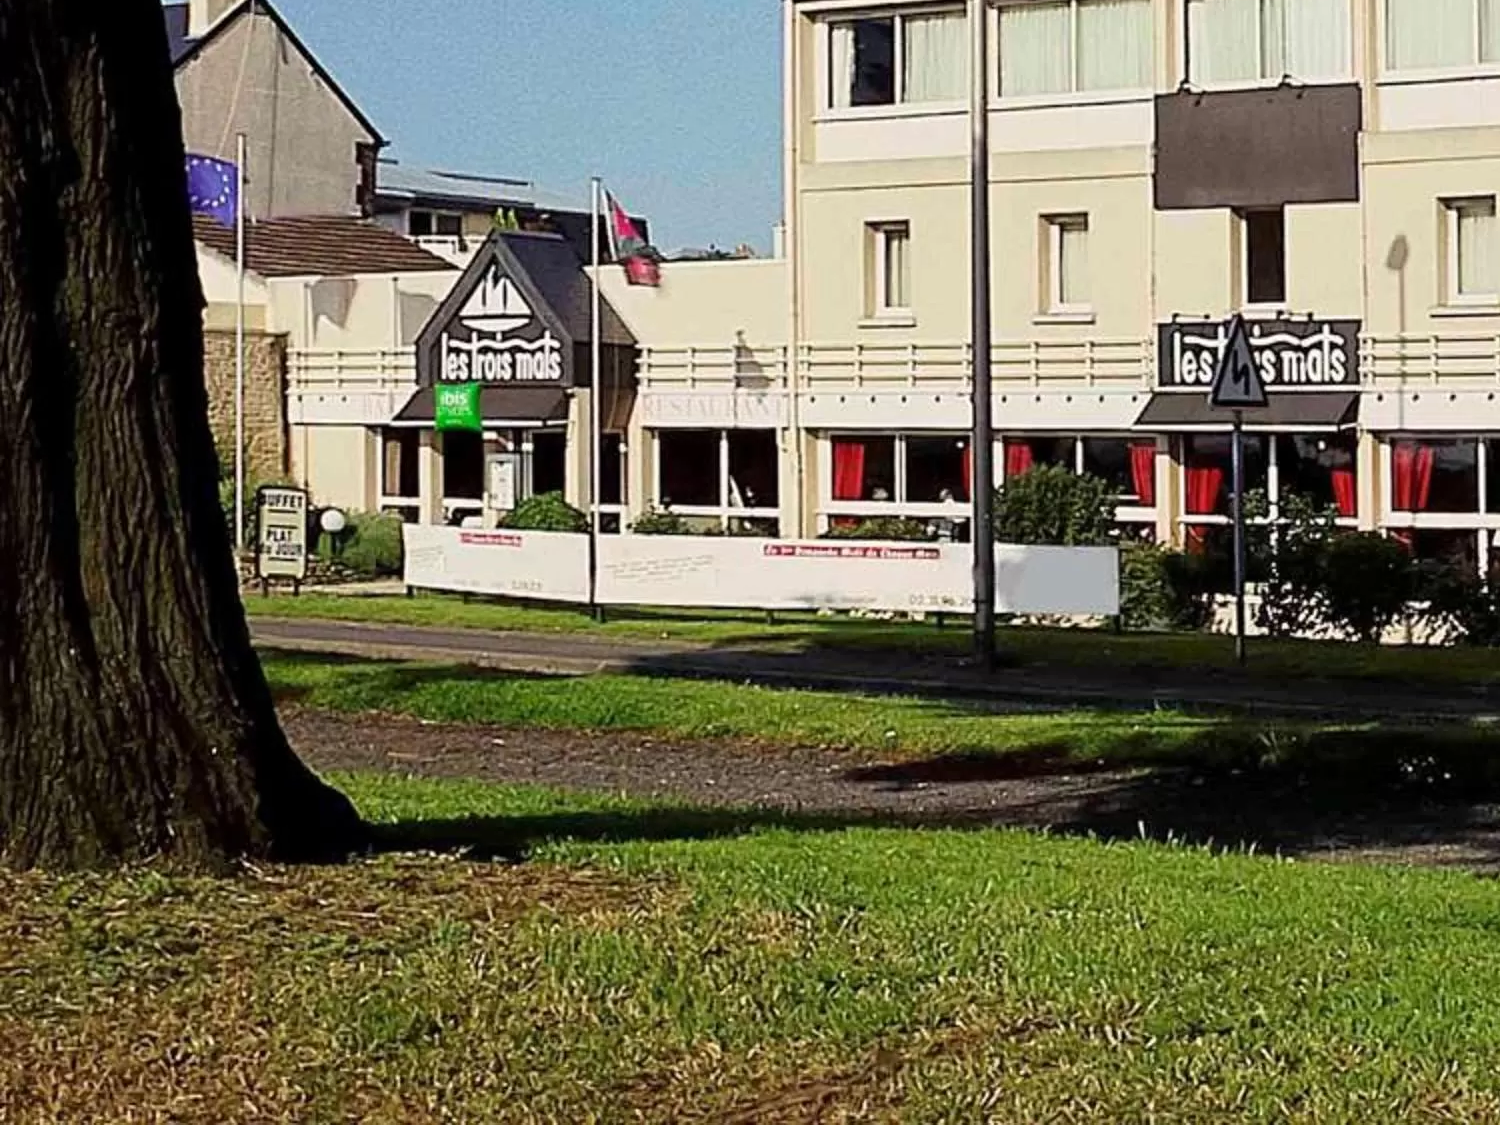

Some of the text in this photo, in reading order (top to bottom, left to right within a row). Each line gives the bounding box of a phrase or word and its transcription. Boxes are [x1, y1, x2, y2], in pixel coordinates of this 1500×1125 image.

[441, 331, 469, 381] les
[471, 331, 513, 381] trois
[1173, 331, 1213, 384] les
[439, 390, 468, 406] ibis
[259, 493, 304, 508] BUFFET
[267, 529, 292, 542] PLAT
